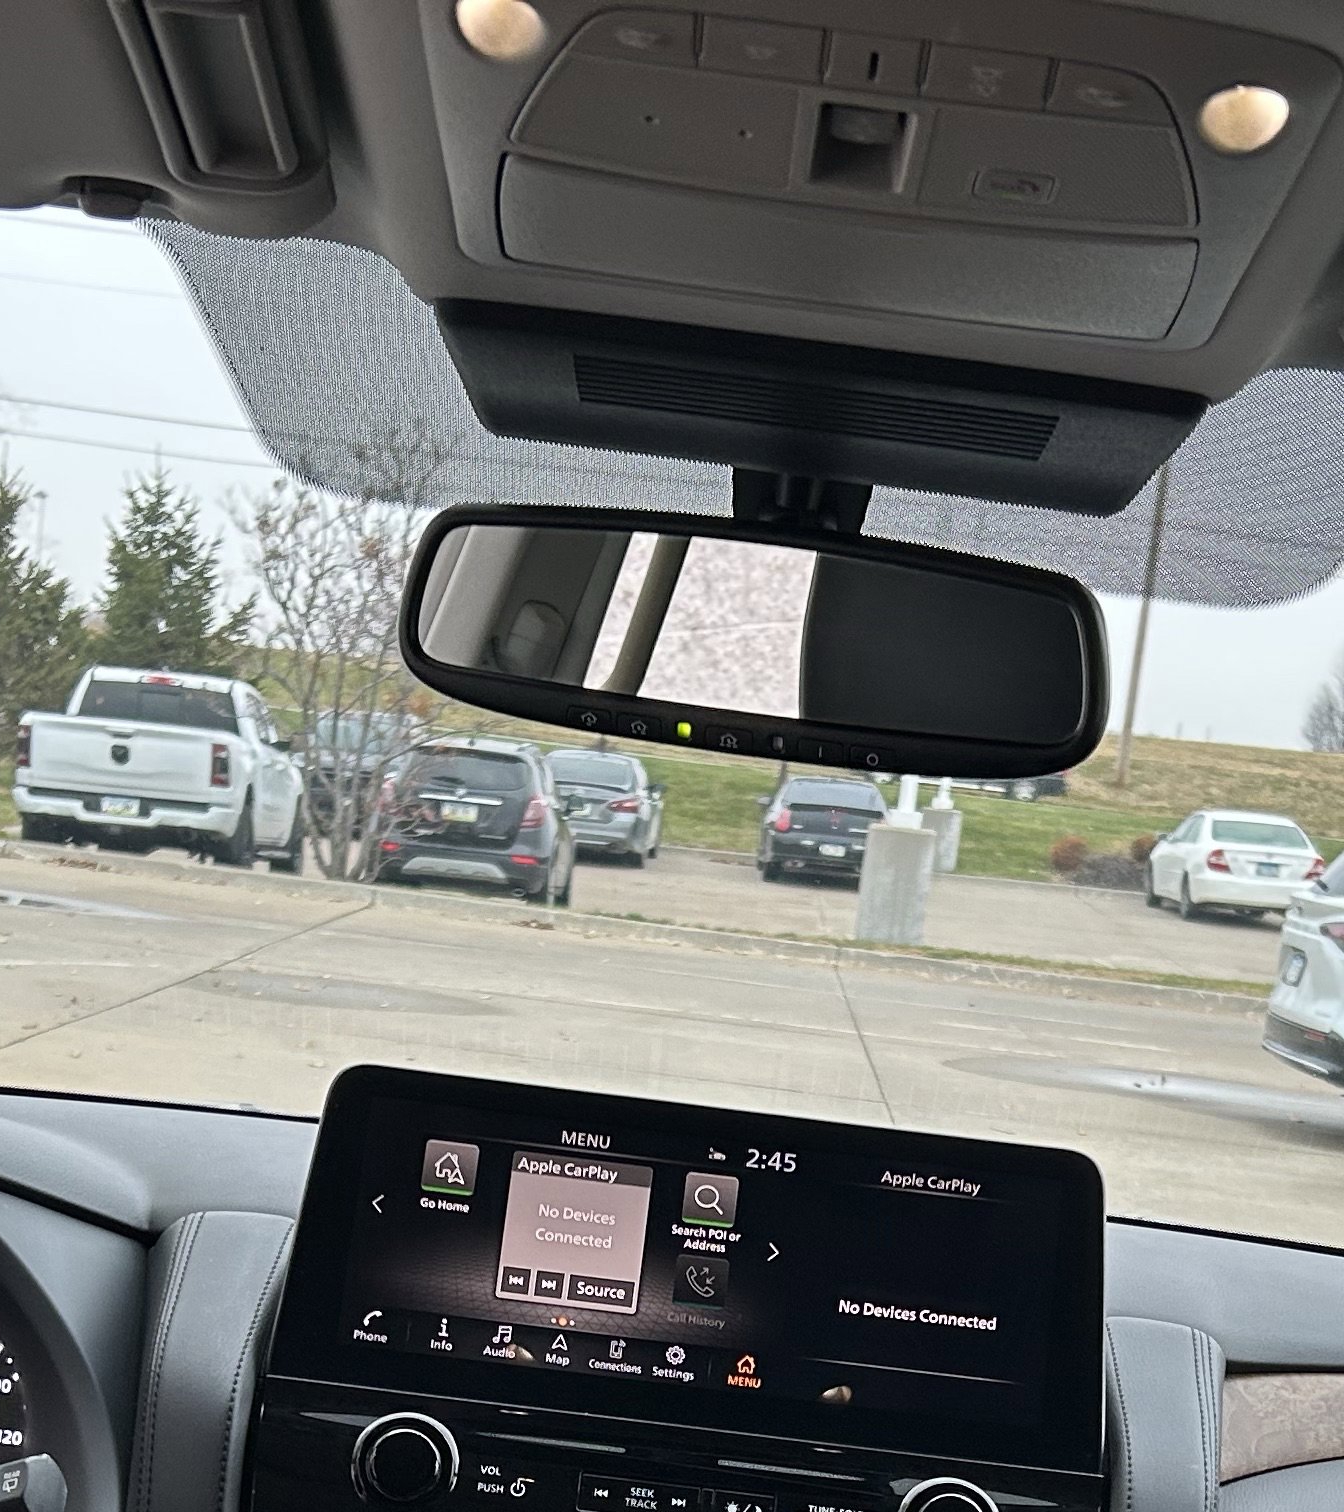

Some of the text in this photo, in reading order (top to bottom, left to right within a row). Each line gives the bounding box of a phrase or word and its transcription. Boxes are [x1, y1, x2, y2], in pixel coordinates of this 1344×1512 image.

[561, 1130, 611, 1149] MENU
[745, 1148, 797, 1173] 2:45
[517, 1156, 618, 1184] Apple CarPlay
[880, 1171, 981, 1197] Apple CarPlay
[419, 1197, 470, 1213] Go Home
[538, 1204, 616, 1226] No Devices
[535, 1228, 613, 1249] Connected
[671, 1224, 741, 1242] Search POI or
[683, 1238, 726, 1253] Address
[576, 1281, 626, 1300] Source
[667, 1311, 726, 1330] Call History
[838, 1299, 997, 1331] No Devices Connected
[353, 1330, 388, 1344] Phone
[430, 1340, 452, 1352] Info
[483, 1345, 516, 1359] Audio
[545, 1354, 570, 1367] Map
[588, 1359, 642, 1374] Connections
[652, 1366, 695, 1382] Settings
[727, 1375, 762, 1389] MENU
[480, 1464, 501, 1477] VOL
[477, 1481, 504, 1494] PUSH
[630, 1487, 655, 1498] SEEK
[624, 1498, 657, 1510] TRACK
